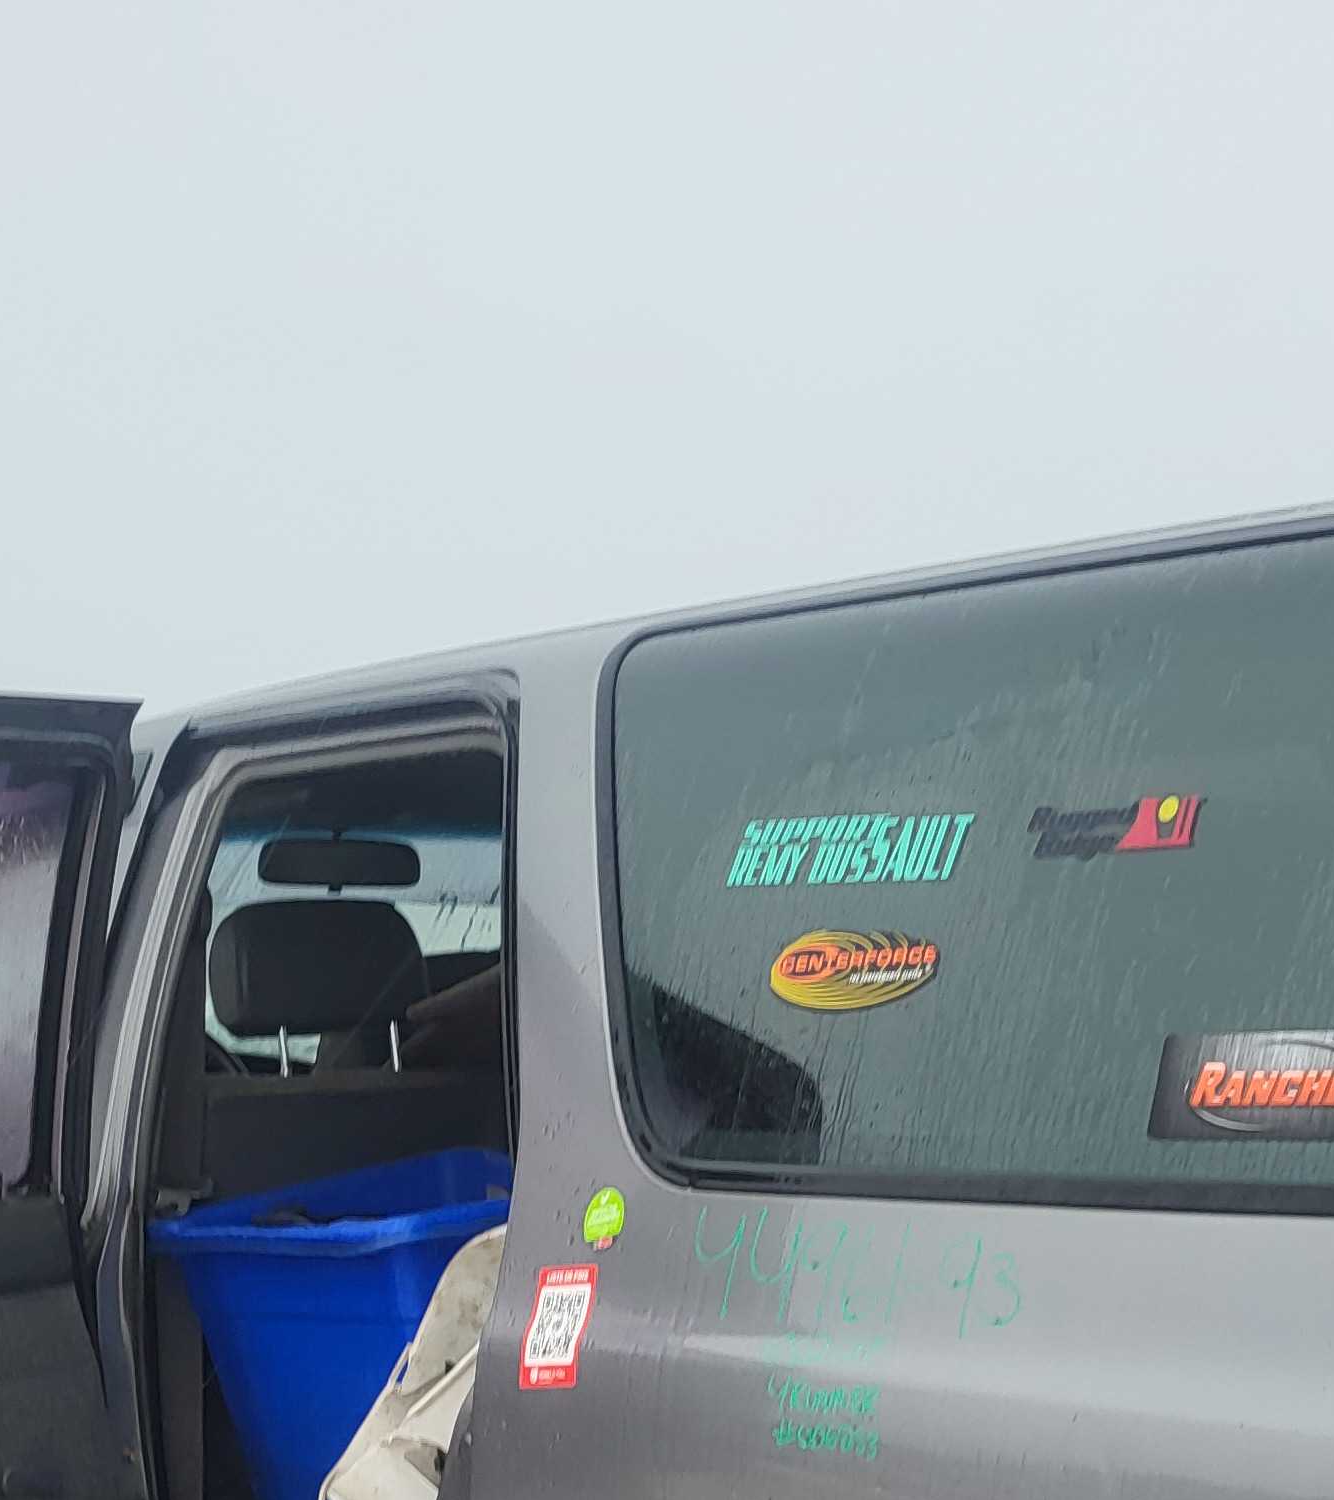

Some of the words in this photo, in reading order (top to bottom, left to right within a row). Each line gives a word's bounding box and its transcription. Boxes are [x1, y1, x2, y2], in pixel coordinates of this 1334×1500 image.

[743, 813, 891, 848] SUPPORT
[726, 843, 810, 888] REMY
[807, 813, 976, 885] DUSSAULT
[780, 943, 937, 977] CENTERFORCE
